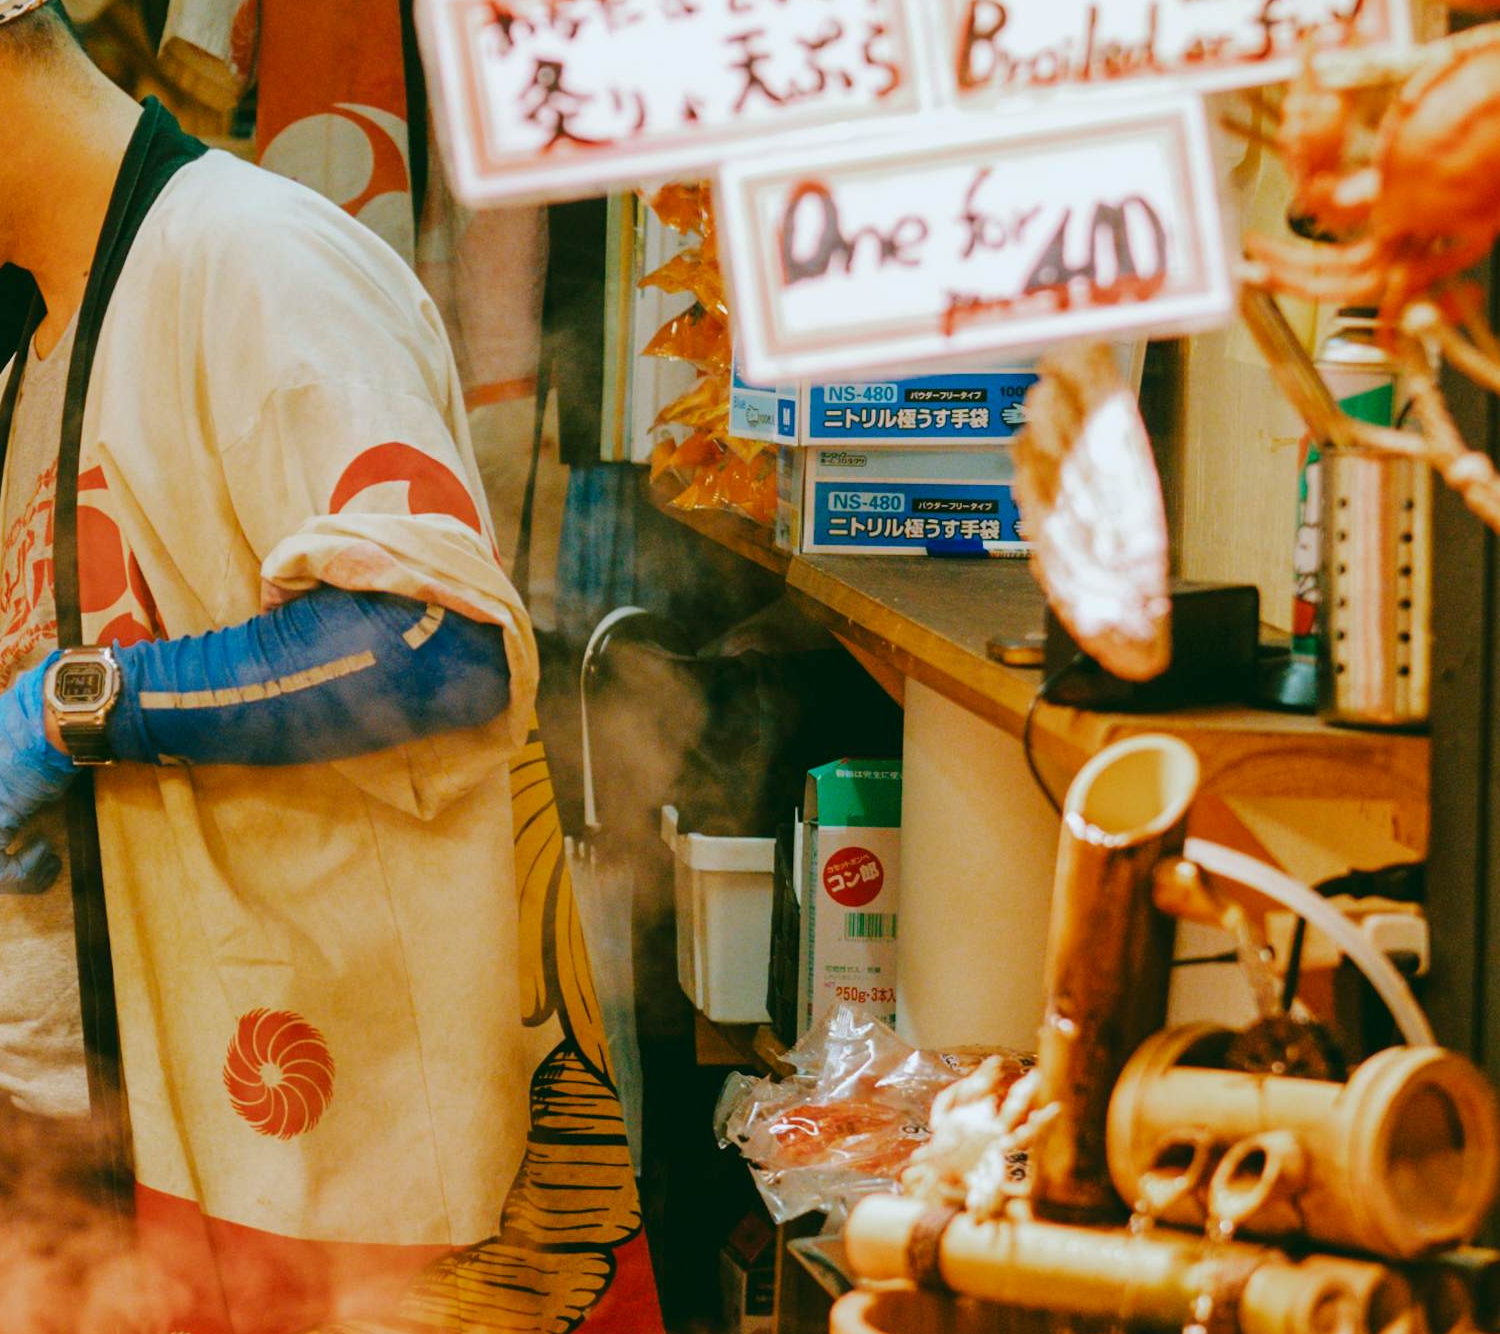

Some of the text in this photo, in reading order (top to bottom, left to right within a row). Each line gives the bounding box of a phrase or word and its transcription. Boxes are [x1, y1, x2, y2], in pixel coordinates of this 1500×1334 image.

[777, 176, 928, 288] One
[956, 166, 1042, 260] for
[828, 386, 894, 402] NS-480
[909, 390, 982, 401] パウダーフリータイプ
[824, 407, 990, 429] ニトリル極うす手袋
[832, 493, 901, 510] NS-480
[918, 500, 993, 511] パウダーフリータイプ
[828, 517, 1000, 540] ニトリル極うす手袋
